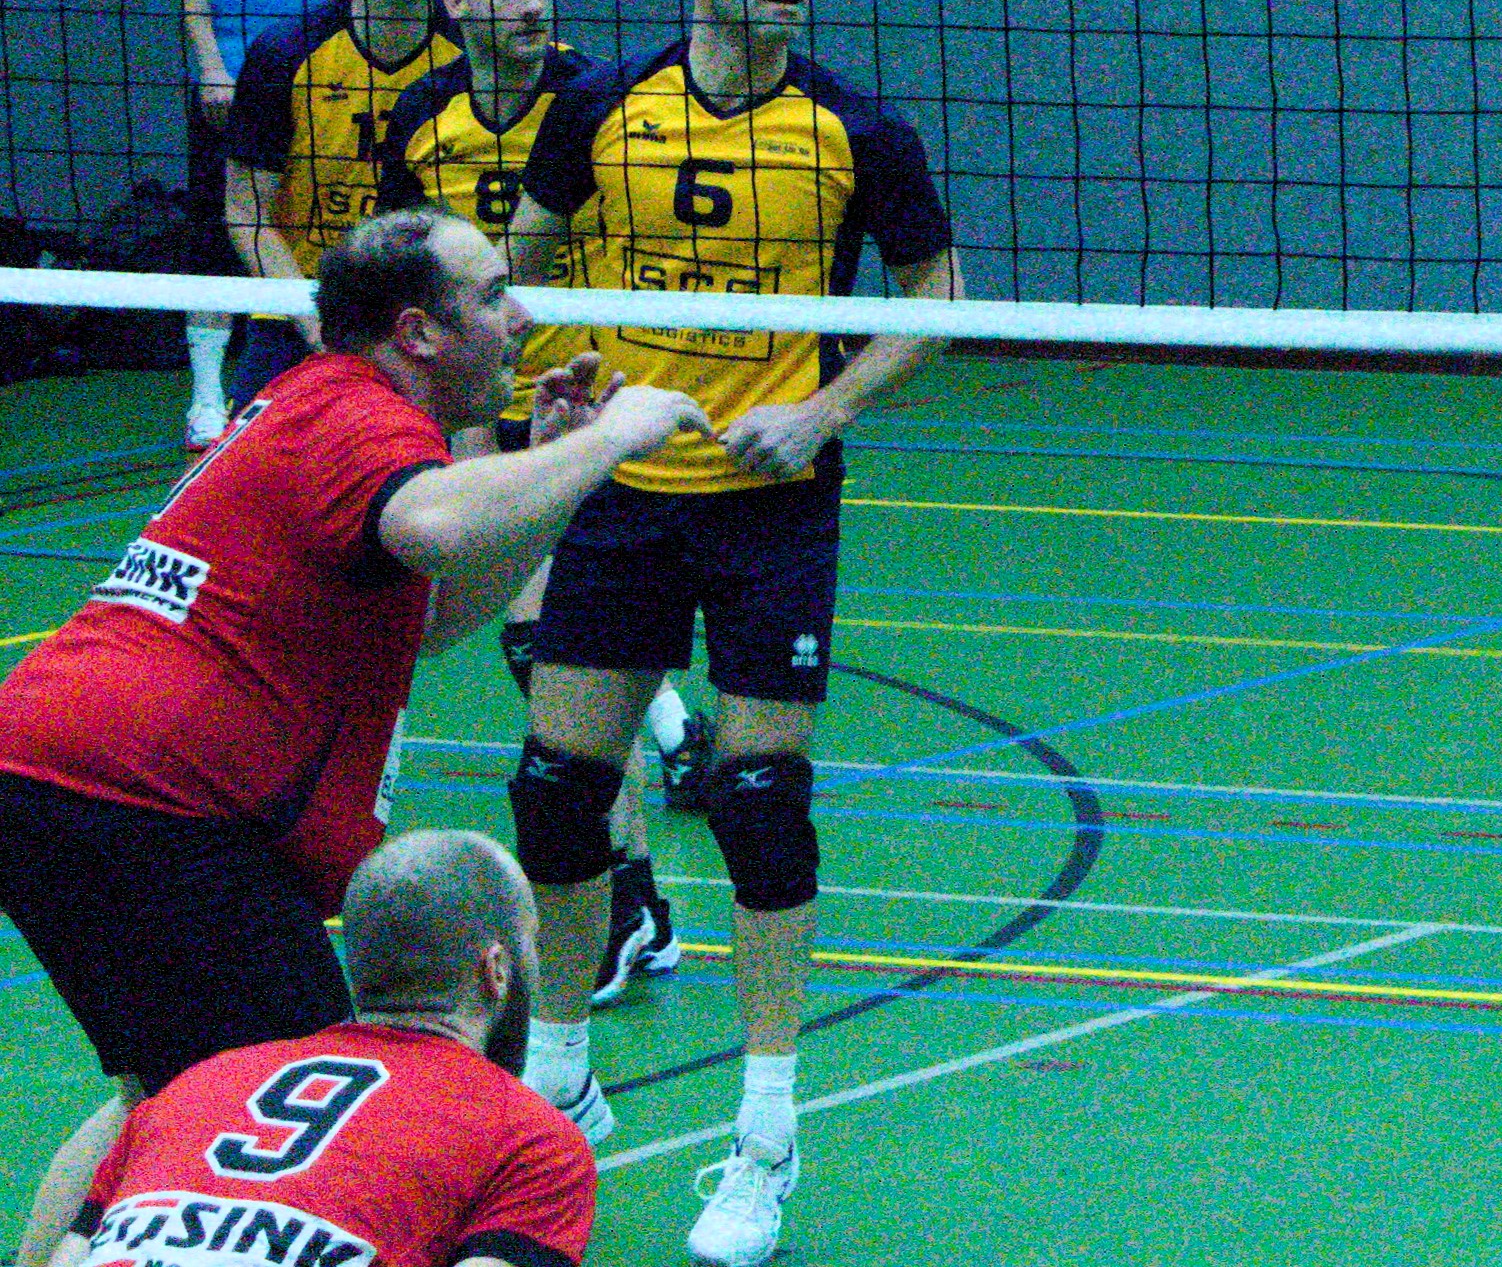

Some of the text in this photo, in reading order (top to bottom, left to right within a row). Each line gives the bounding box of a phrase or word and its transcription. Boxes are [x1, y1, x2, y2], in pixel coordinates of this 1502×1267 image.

[475, 170, 523, 225] 8
[673, 158, 735, 227] 6
[205, 1055, 391, 1182] 9
